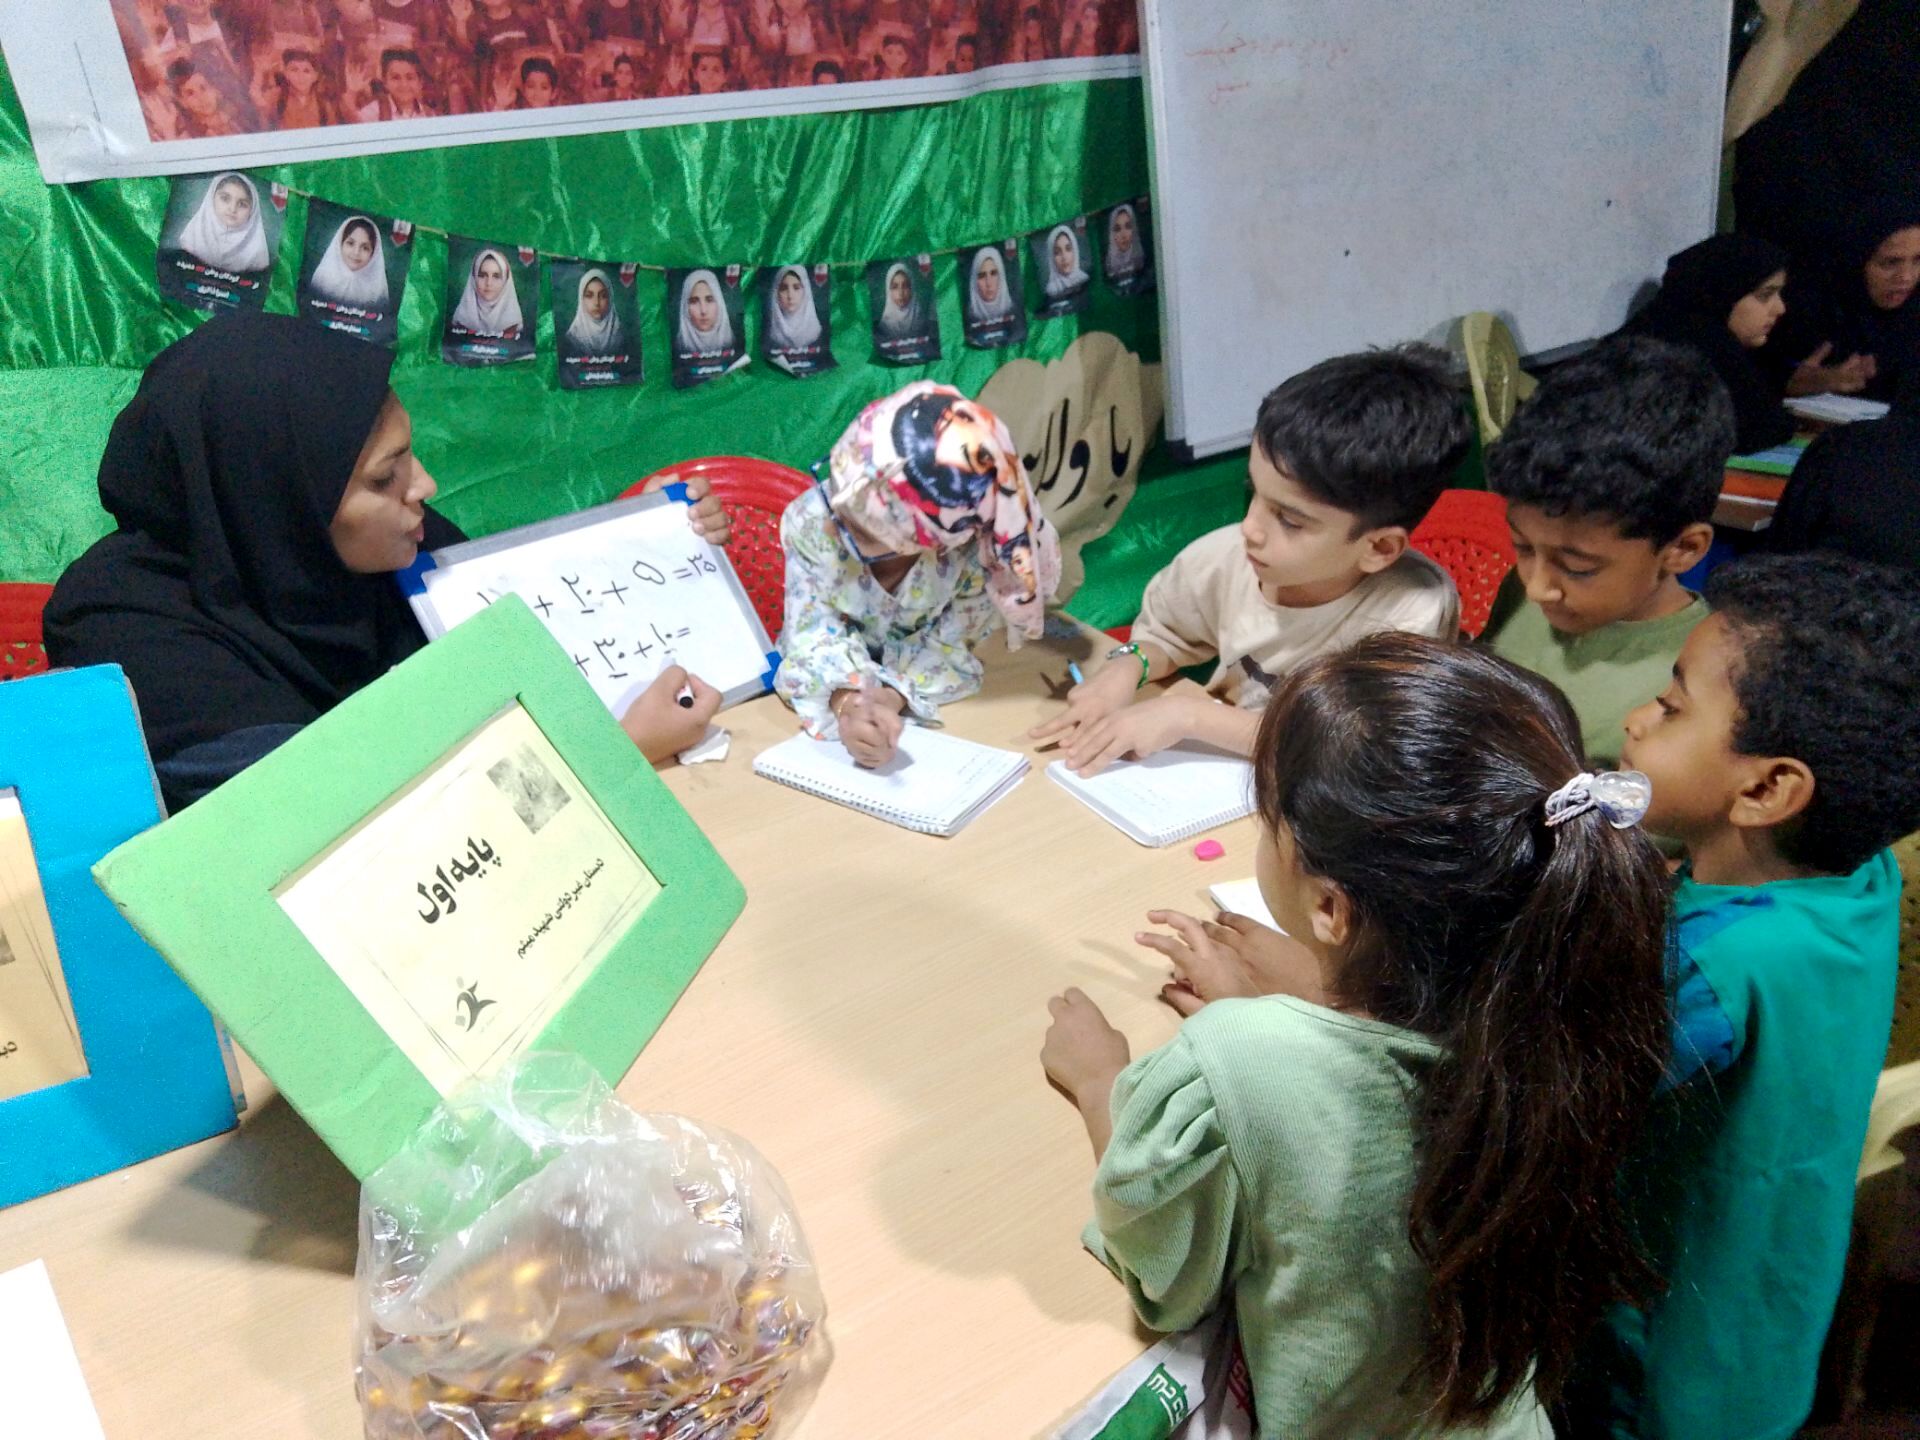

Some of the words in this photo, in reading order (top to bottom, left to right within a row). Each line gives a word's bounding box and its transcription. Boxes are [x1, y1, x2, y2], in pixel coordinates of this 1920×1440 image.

[450, 836, 502, 883] پایه
[583, 858, 605, 888] دبستان
[417, 864, 457, 924] اول
[532, 913, 553, 937] شهید
